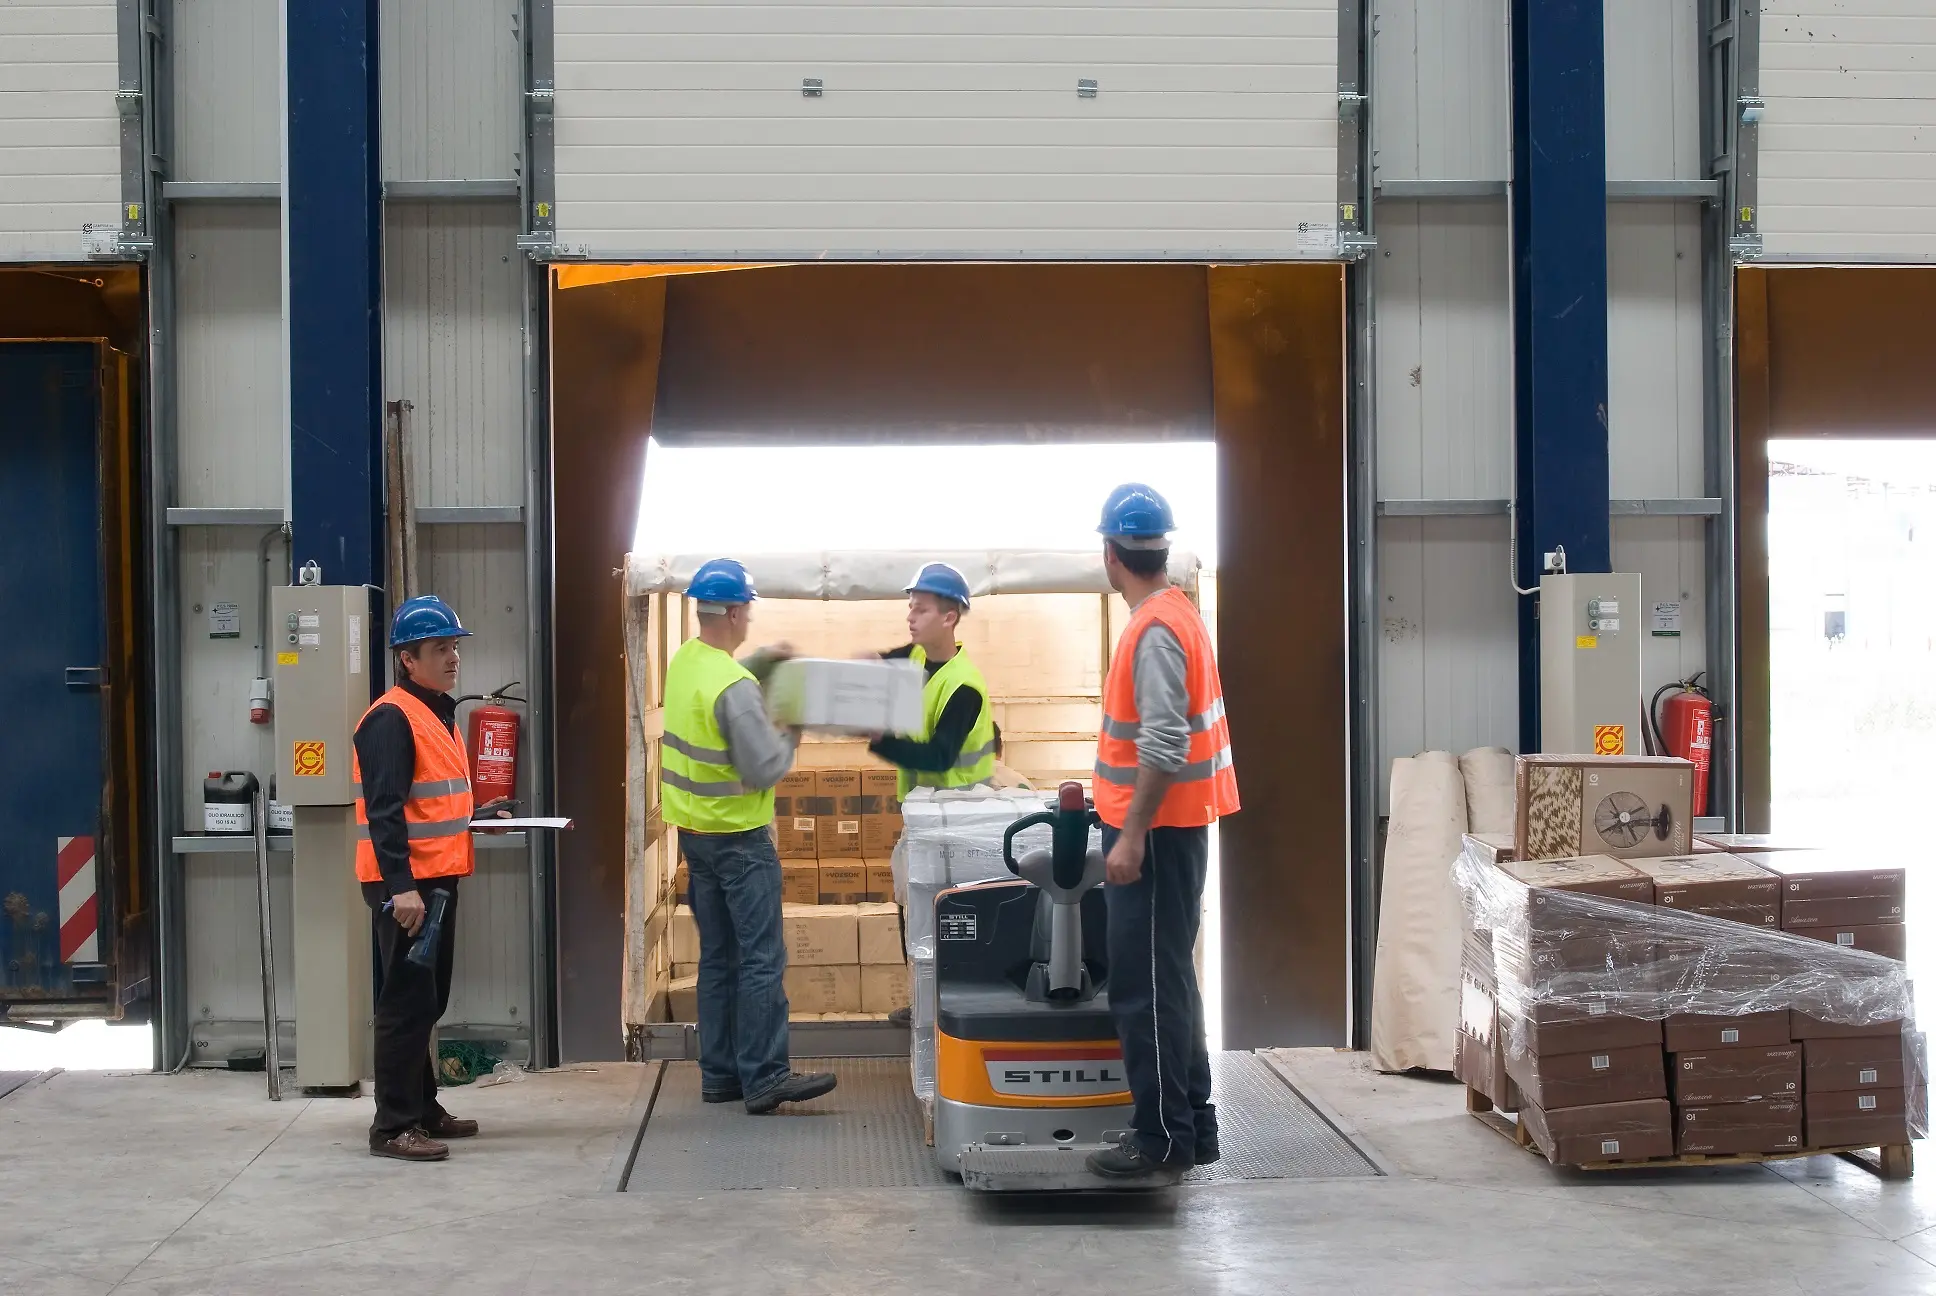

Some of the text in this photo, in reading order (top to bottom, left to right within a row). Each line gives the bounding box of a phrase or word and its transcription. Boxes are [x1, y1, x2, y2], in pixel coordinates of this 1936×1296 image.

[1620, 882, 1649, 890] Amazon
[1747, 883, 1777, 891] Amazon
[1789, 915, 1818, 924] Amazon
[1767, 1050, 1796, 1059] Amazon
[1005, 1070, 1121, 1082] STILL
[1769, 1102, 1798, 1112] Amazon
